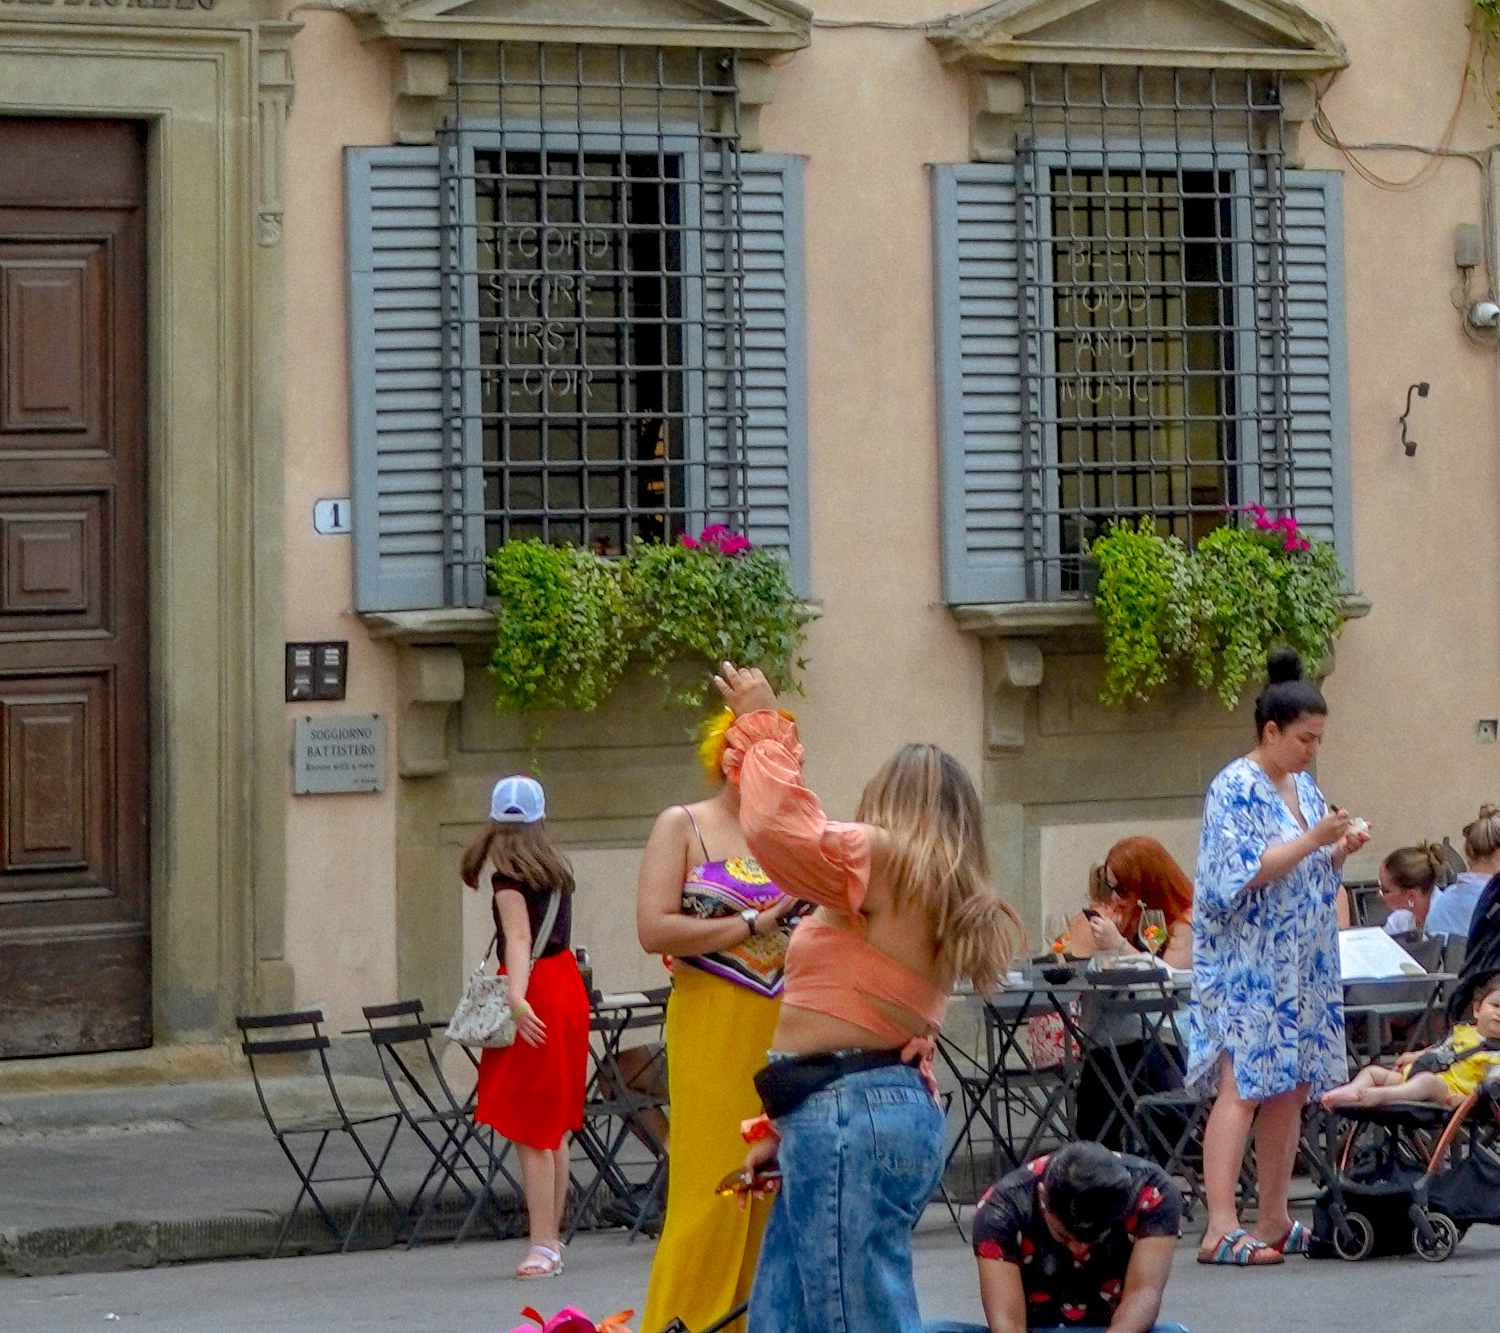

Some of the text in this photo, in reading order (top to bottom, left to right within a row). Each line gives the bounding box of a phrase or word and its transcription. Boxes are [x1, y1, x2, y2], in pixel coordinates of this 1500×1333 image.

[331, 503, 342, 528] 1
[310, 727, 373, 741] SOGGIORNO
[306, 744, 376, 758] BATTISTERO
